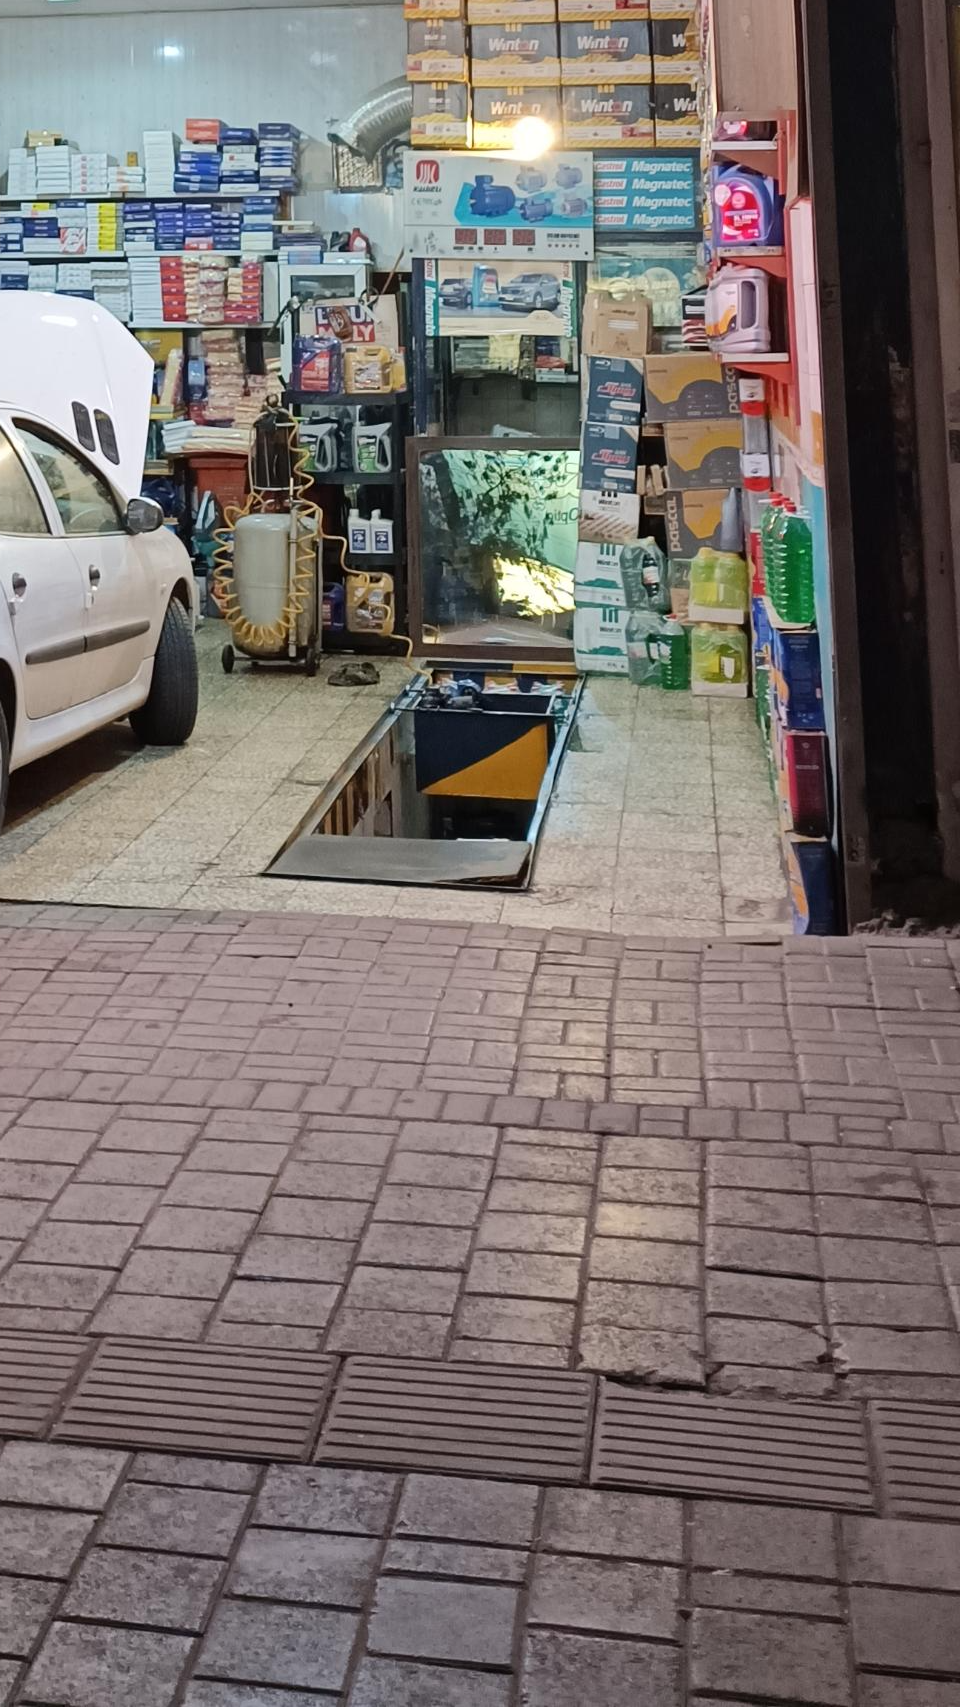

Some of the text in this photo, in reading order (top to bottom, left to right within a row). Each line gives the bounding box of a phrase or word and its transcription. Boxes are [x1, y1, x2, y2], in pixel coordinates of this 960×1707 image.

[488, 37, 540, 53] Winton
[577, 35, 630, 50] Winton
[580, 98, 633, 113] Winton
[631, 161, 692, 175] Magnatec
[632, 178, 692, 192] Magnatec
[632, 196, 693, 210] Magnatec
[633, 213, 693, 228] Magnatec
[666, 496, 683, 553] pascal
